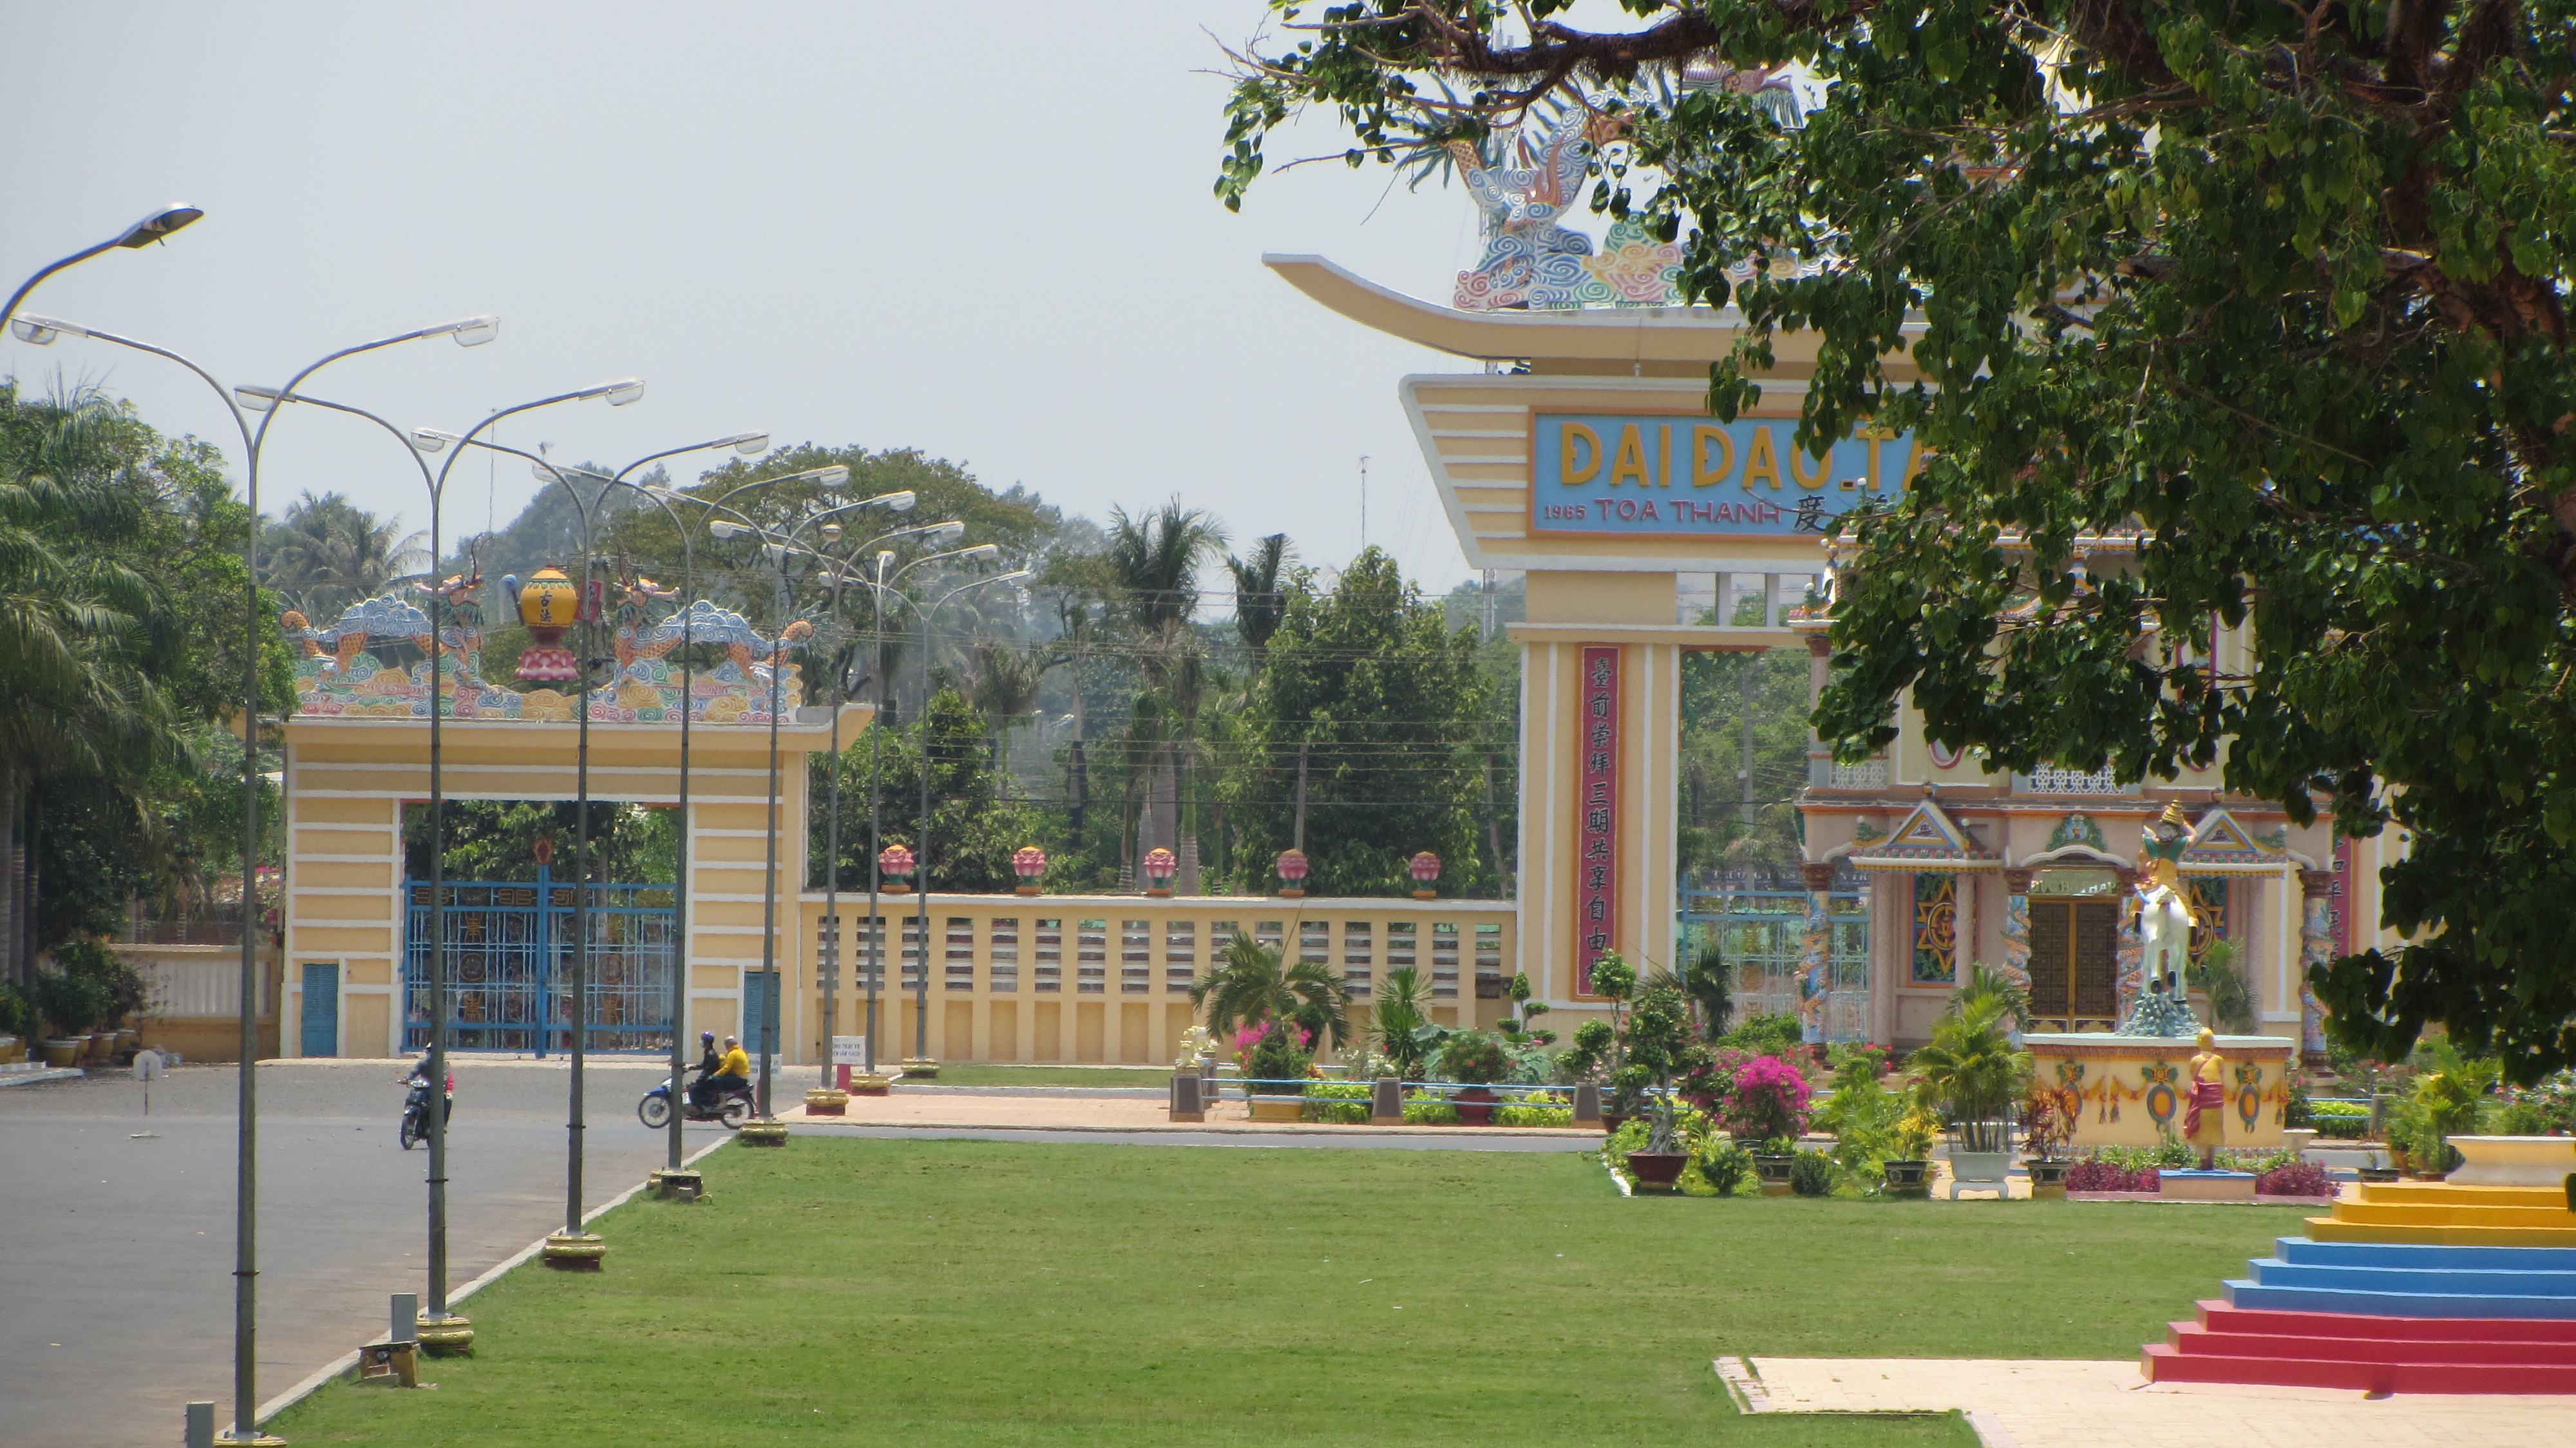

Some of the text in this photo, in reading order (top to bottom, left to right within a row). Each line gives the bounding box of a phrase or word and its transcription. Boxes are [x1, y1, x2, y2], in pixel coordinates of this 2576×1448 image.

[1545, 497, 1781, 524] 1965 TOA THANH
